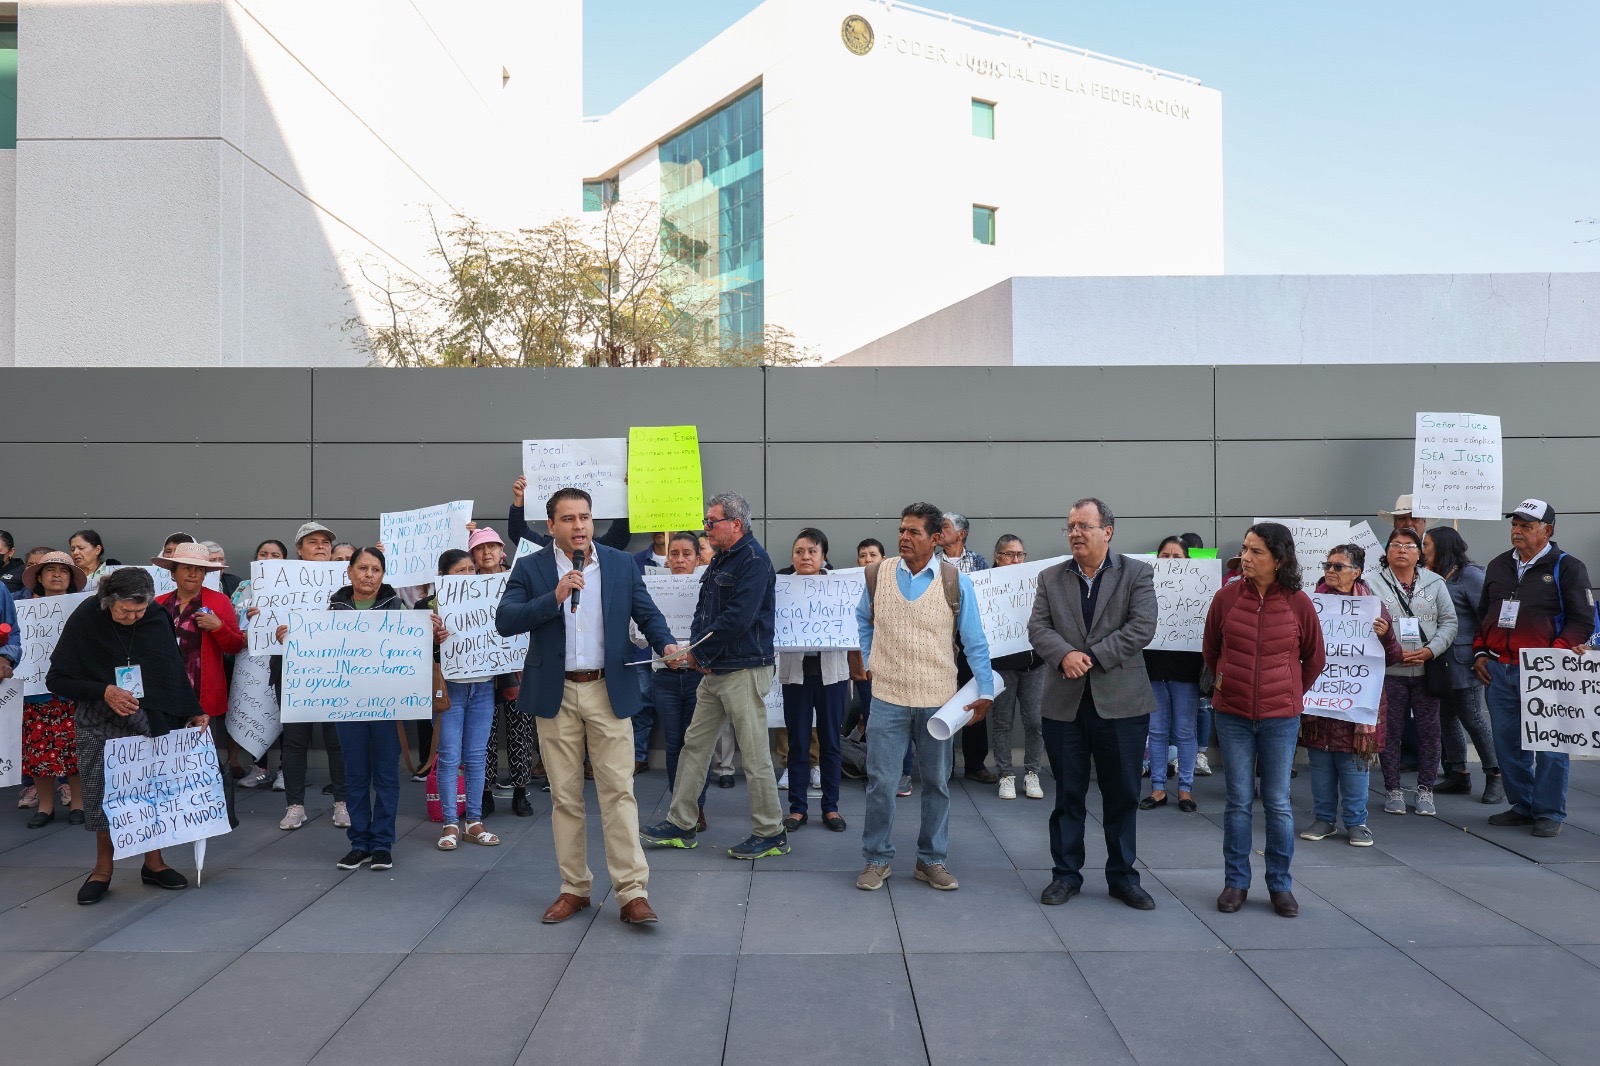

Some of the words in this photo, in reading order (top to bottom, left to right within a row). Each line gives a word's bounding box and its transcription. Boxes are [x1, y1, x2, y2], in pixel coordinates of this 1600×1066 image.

[884, 34, 948, 64] PODER
[955, 52, 1034, 83] JUDICIAL
[1039, 71, 1060, 89] DE
[1065, 76, 1086, 95] LA
[1091, 82, 1191, 120] FEDERACIÓN
[1420, 414, 1455, 429] Señor
[1460, 414, 1488, 430] Juez
[1420, 448, 1444, 461] SEA
[1452, 449, 1494, 464] JUSTO
[1518, 502, 1538, 511] STAFF
[382, 528, 393, 542] SI
[397, 526, 411, 539] NO
[1290, 526, 1329, 538] UTADA
[404, 538, 416, 554] EL
[1341, 598, 1362, 616] DE
[287, 611, 370, 640] Diputado
[378, 611, 425, 638] Arturo
[800, 620, 843, 634] 2027
[285, 637, 373, 660] Maximiliano
[380, 638, 423, 660] García
[1521, 651, 1556, 672] Les
[305, 675, 352, 694] ayuda
[1525, 675, 1575, 693] Dando
[285, 693, 349, 708] Tenemos
[356, 695, 396, 708] cinco
[400, 692, 432, 708] años
[1526, 697, 1586, 719] Quieren
[327, 707, 396, 720] esperando!
[1525, 720, 1588, 748] Hagamos
[151, 736, 169, 757] NO
[111, 769, 131, 790] UN
[137, 760, 167, 782] JUEZ
[170, 750, 216, 775] JUSTO
[106, 789, 127, 810] EN
[111, 811, 137, 830] QUE
[170, 814, 178, 832] Y
